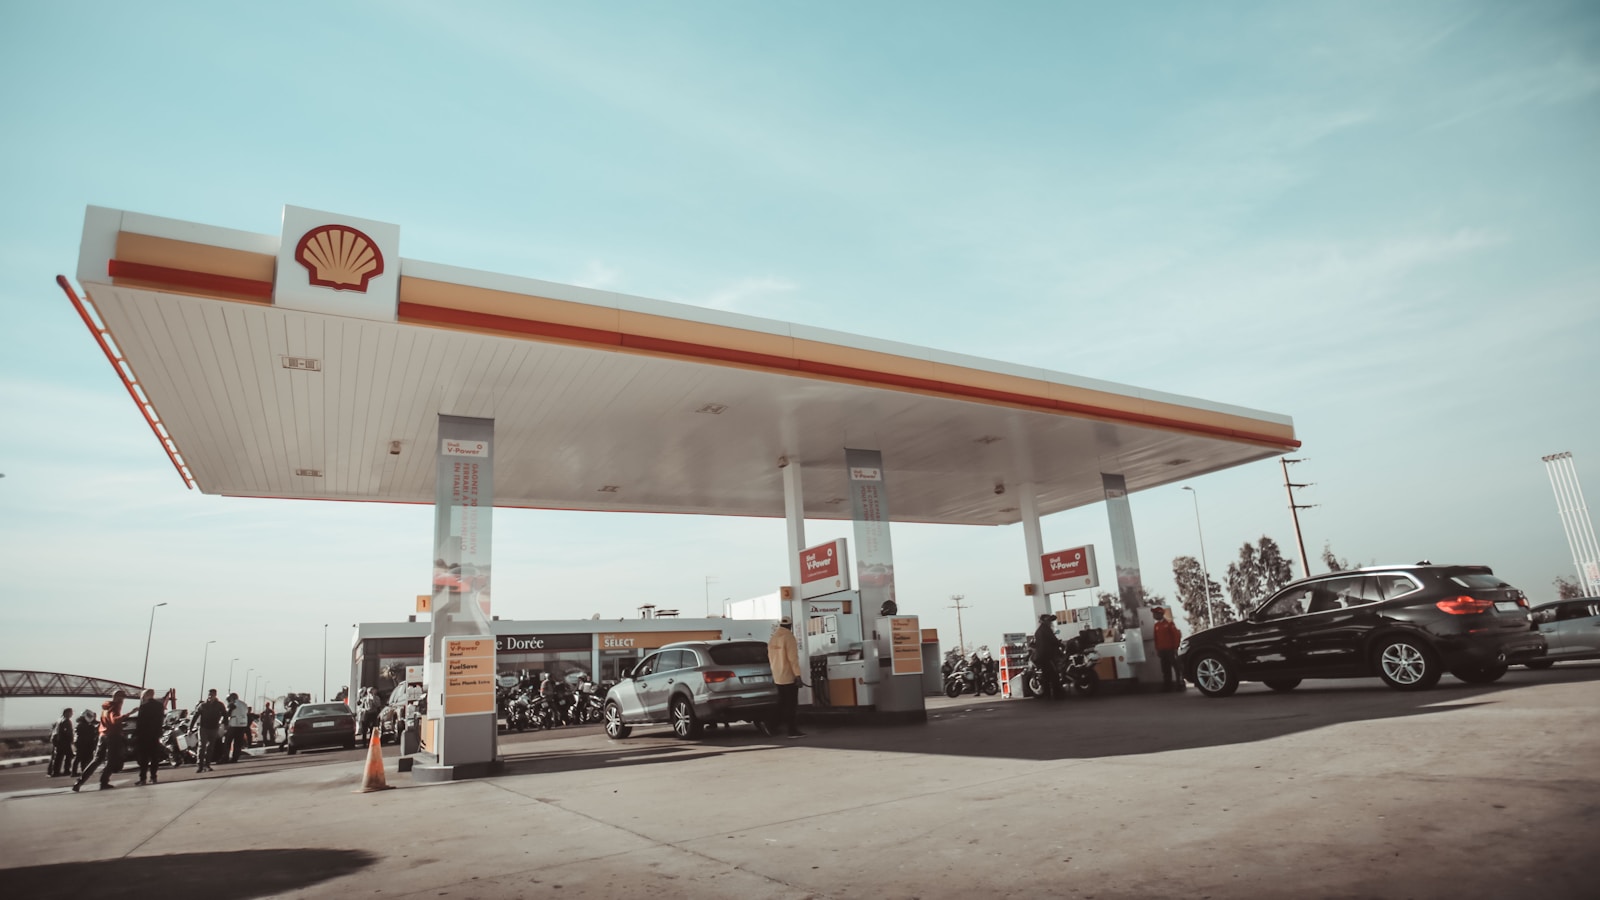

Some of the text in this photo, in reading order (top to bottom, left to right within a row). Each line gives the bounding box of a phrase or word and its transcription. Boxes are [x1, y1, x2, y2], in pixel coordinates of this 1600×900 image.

[447, 447, 480, 455] V-Power
[454, 462, 461, 473] EN
[806, 558, 831, 571] V-Power
[1050, 561, 1079, 570] V-Power
[422, 599, 426, 608] 1
[507, 636, 544, 650] Dorée
[604, 639, 634, 648] SELECT
